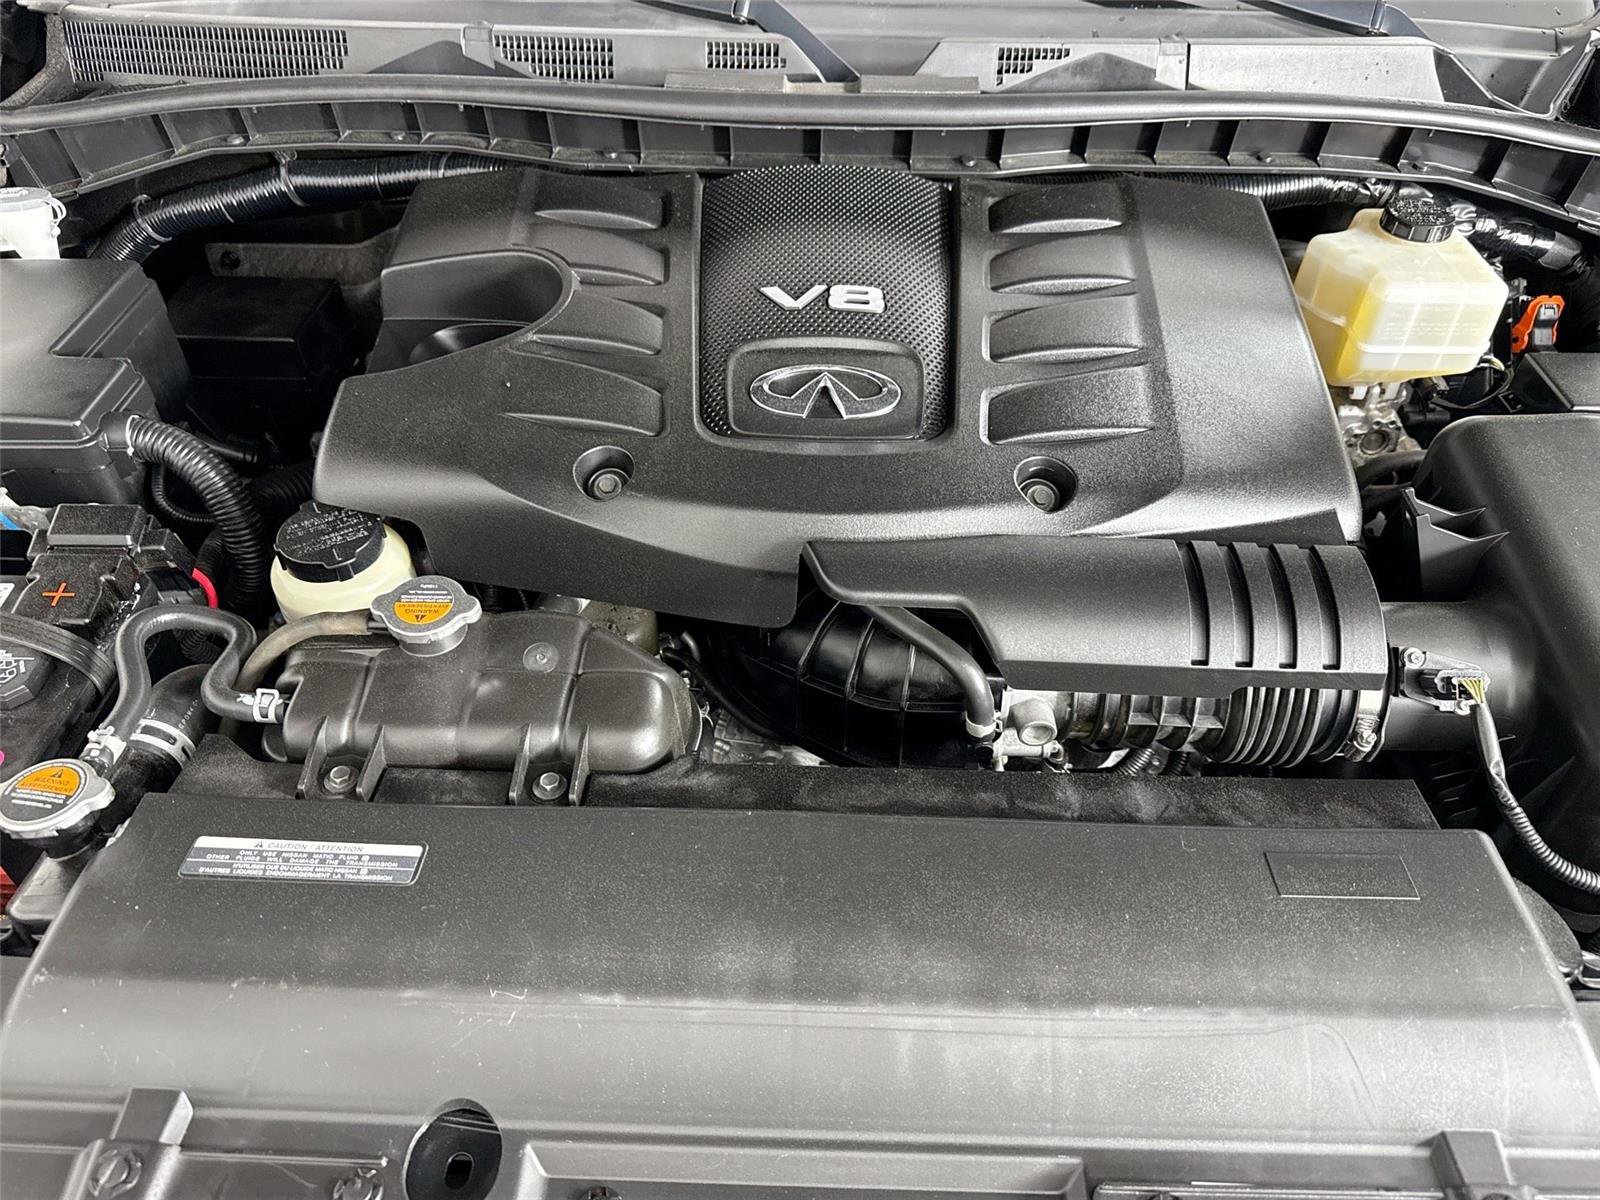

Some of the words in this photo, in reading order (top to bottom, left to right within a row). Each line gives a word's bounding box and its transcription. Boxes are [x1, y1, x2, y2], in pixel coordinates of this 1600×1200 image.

[760, 285, 885, 313] V8
[267, 842, 308, 850] CAUTION
[315, 844, 365, 852] ATTENTION
[344, 873, 393, 881] TRANSMISSION
